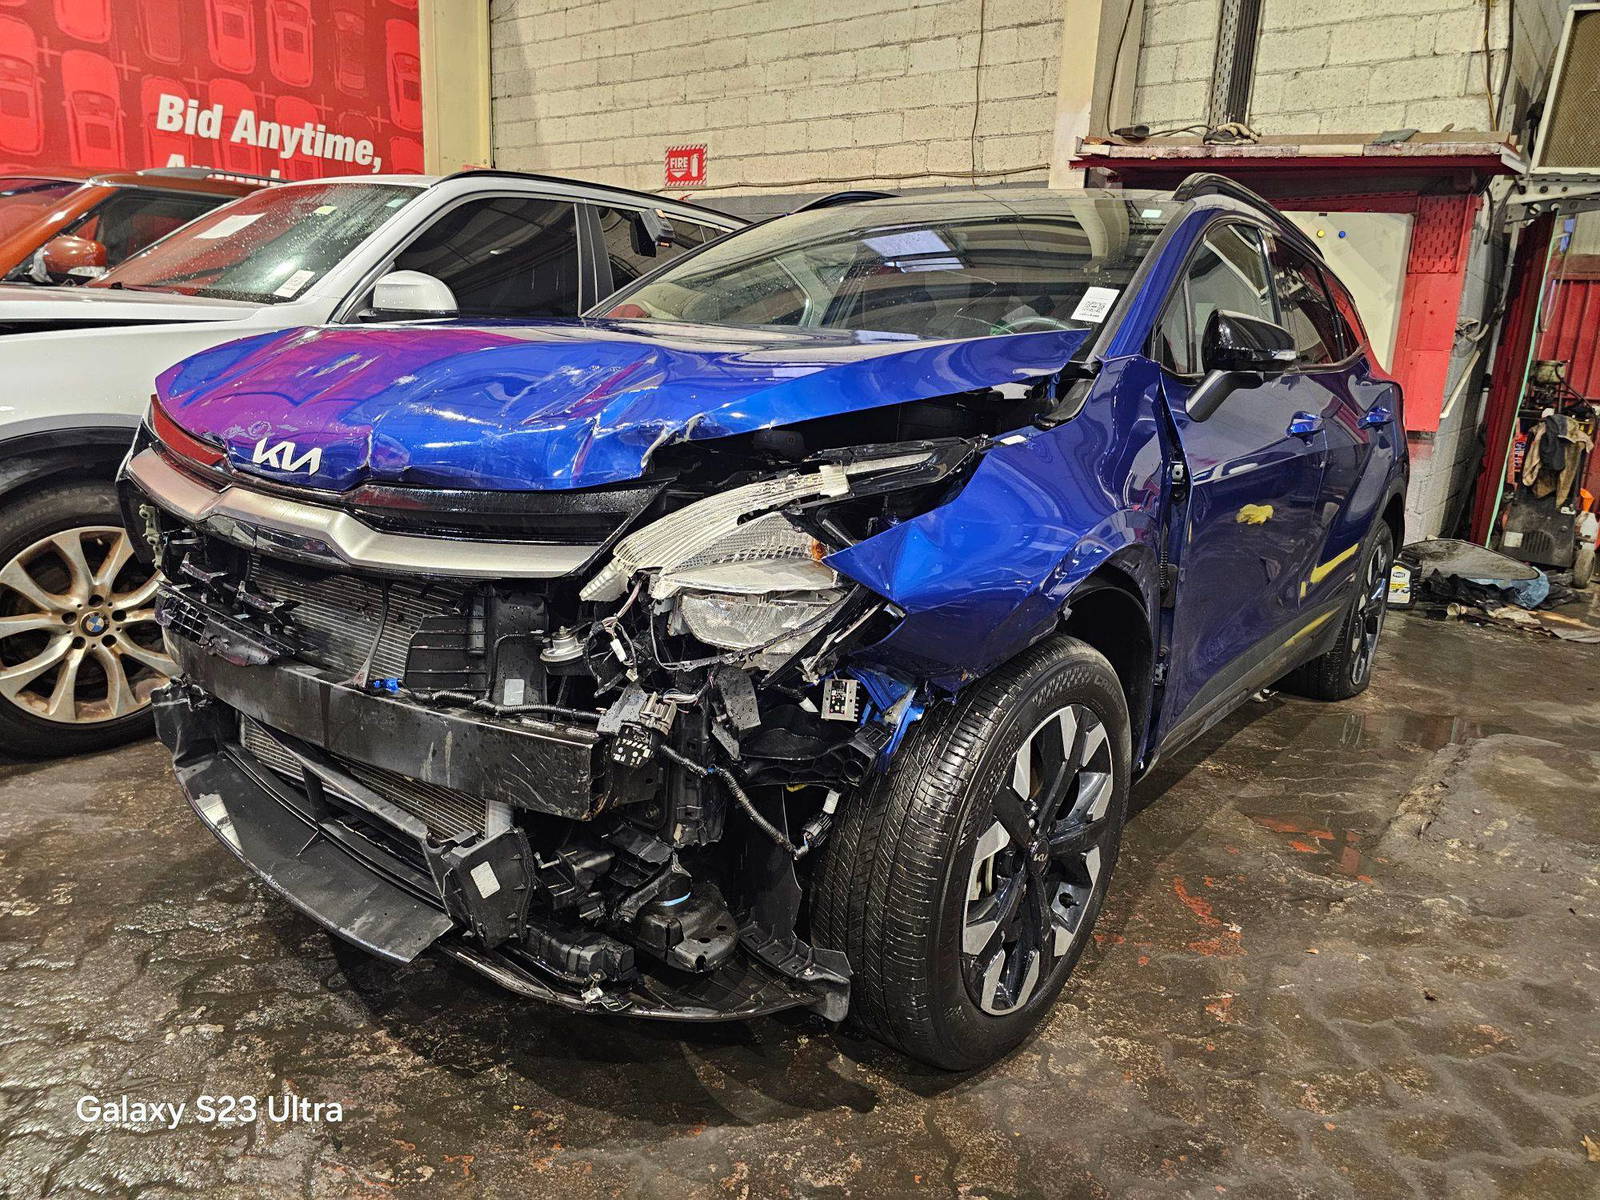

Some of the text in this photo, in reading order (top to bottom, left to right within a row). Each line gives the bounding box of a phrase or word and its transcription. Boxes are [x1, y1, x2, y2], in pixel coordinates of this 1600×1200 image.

[156, 93, 223, 139] Bid
[231, 109, 382, 173] Anytime,
[669, 156, 688, 168] FIRE
[252, 437, 322, 476] KIA
